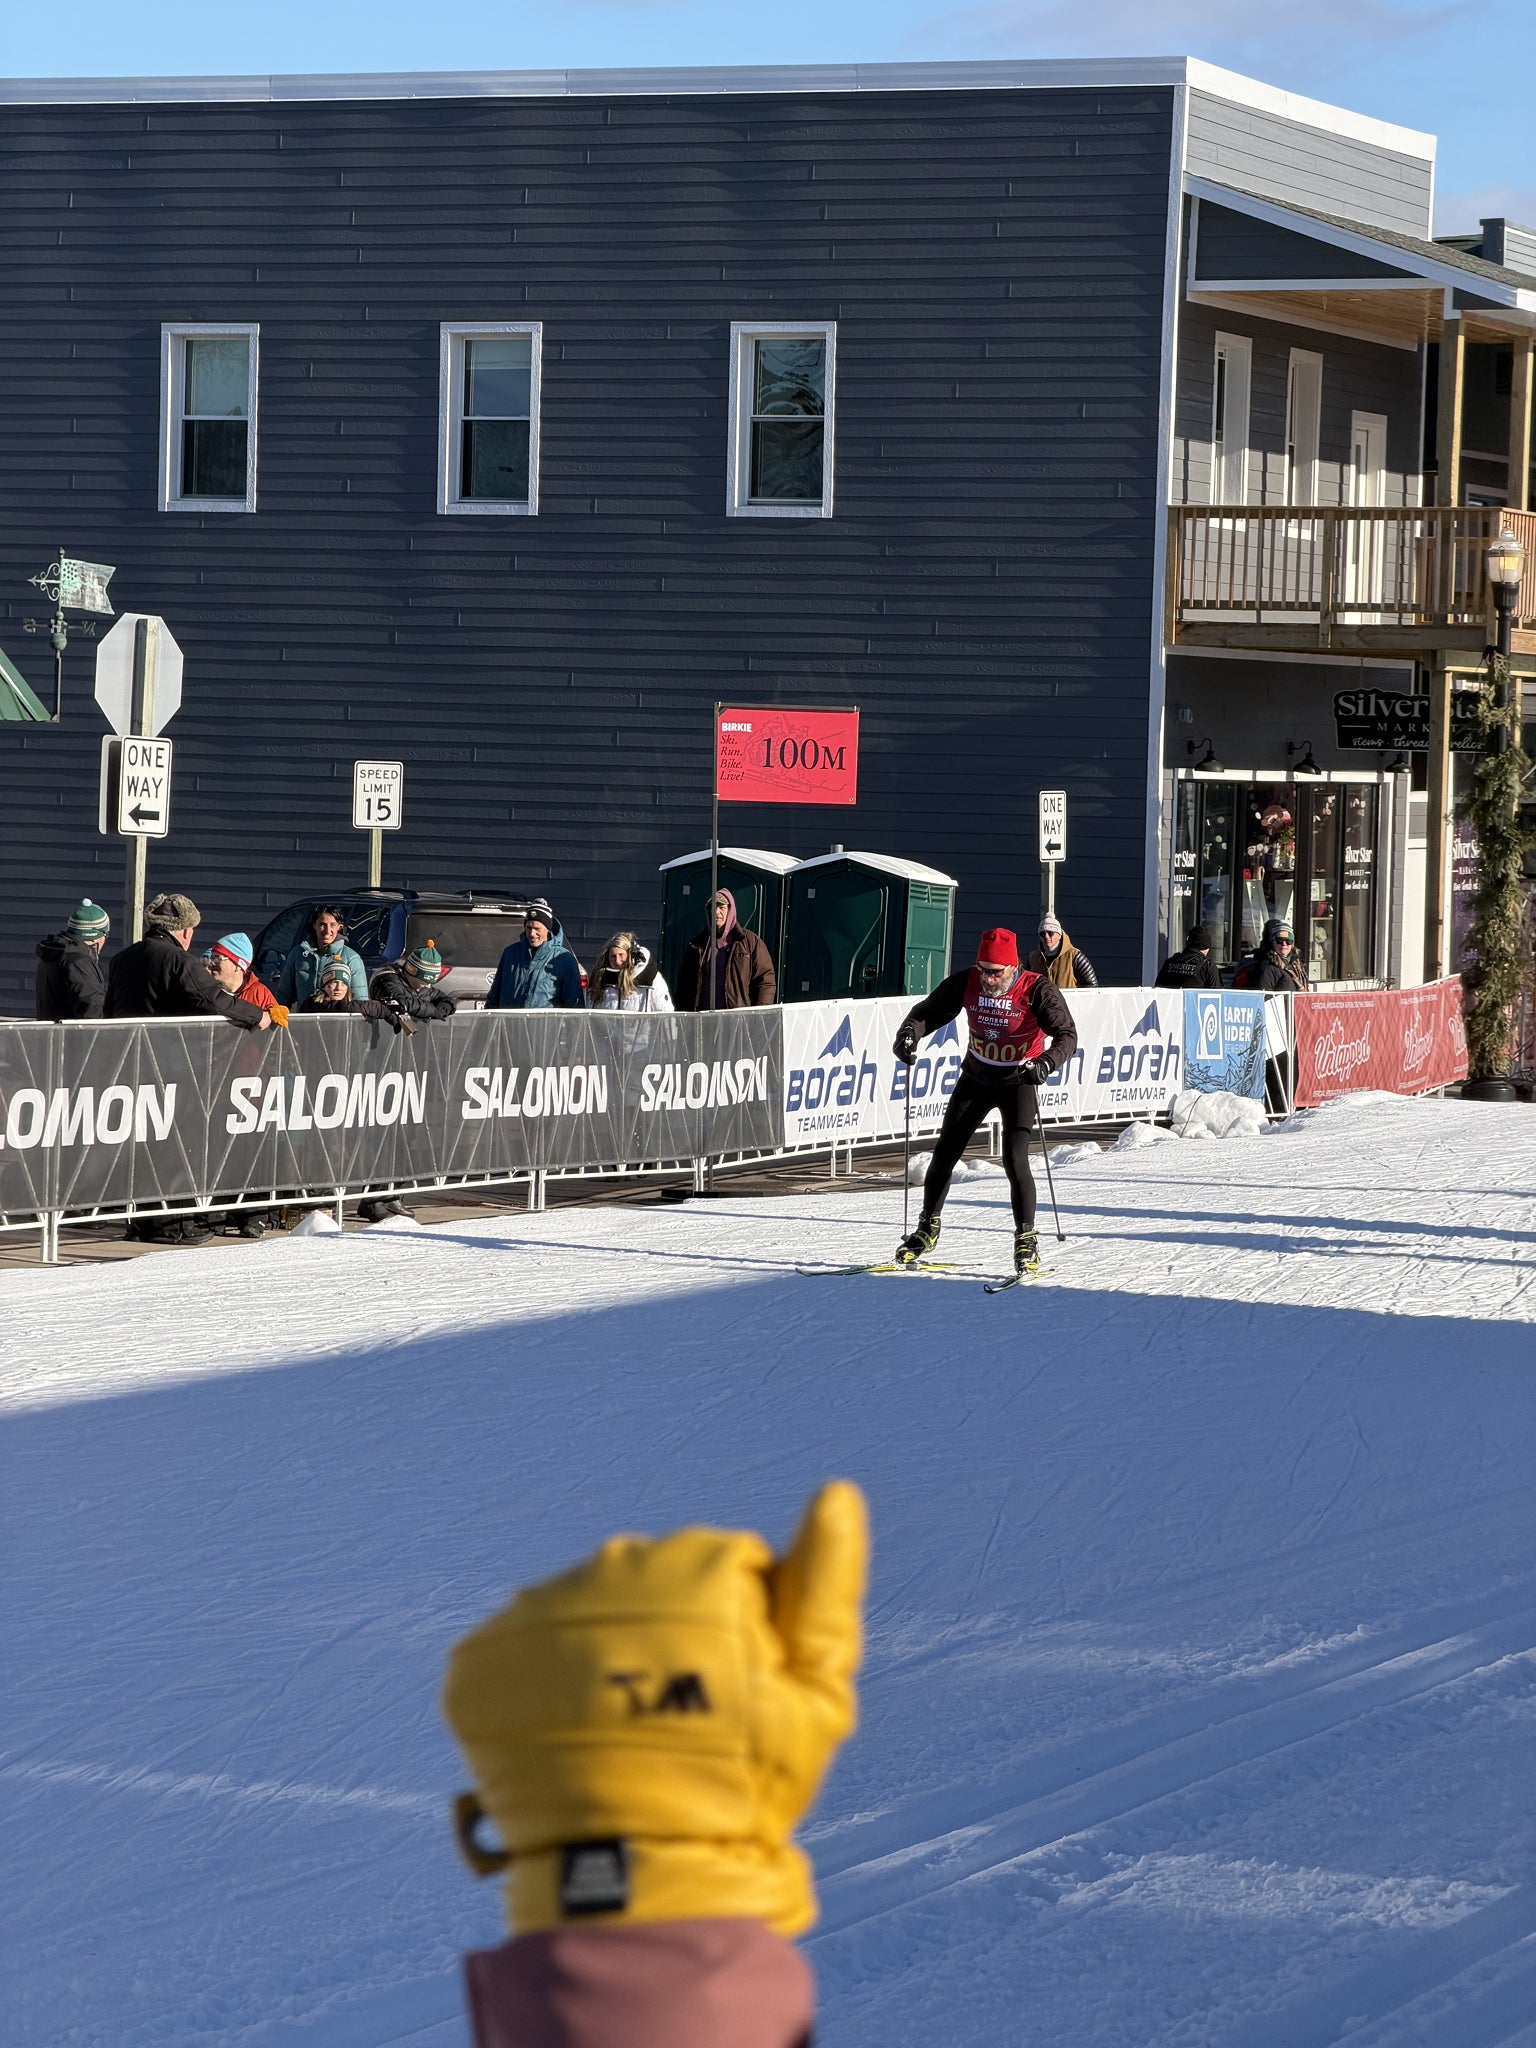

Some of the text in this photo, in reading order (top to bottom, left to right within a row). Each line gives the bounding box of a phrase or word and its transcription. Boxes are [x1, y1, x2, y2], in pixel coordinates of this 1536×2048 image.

[1338, 693, 1429, 718] Silver
[721, 722, 752, 732] BIRKIE
[1377, 723, 1457, 733] MARKT
[720, 735, 738, 745] Ski.
[1352, 736, 1384, 747] stems
[1393, 734, 1430, 748] threa
[128, 745, 165, 768] ONE
[720, 747, 743, 756] Run.
[762, 737, 847, 770] 100M
[720, 758, 743, 769] Bike.
[360, 769, 399, 780] SPEED
[720, 771, 745, 781] Live!
[127, 775, 163, 798] WAY
[364, 783, 393, 793] LIMIT
[365, 797, 391, 822] 15
[1043, 797, 1063, 813] ONE
[1043, 818, 1063, 835] WAY
[978, 996, 1013, 1010] BIRKIE
[978, 1015, 1009, 1025] PIONEER
[640, 1056, 768, 1112] SALOMON
[786, 1049, 878, 1112] Borah
[889, 1055, 962, 1101] Bora
[462, 1065, 607, 1120] SALOMON
[1038, 1092, 1069, 1107] WEAR
[1110, 1087, 1166, 1102] TEAMWAR
[226, 1071, 428, 1134] SALOMON
[0, 1083, 177, 1150] OMON
[904, 1102, 950, 1120] TEAMWE
[797, 1112, 859, 1133] TEAMWEAR
